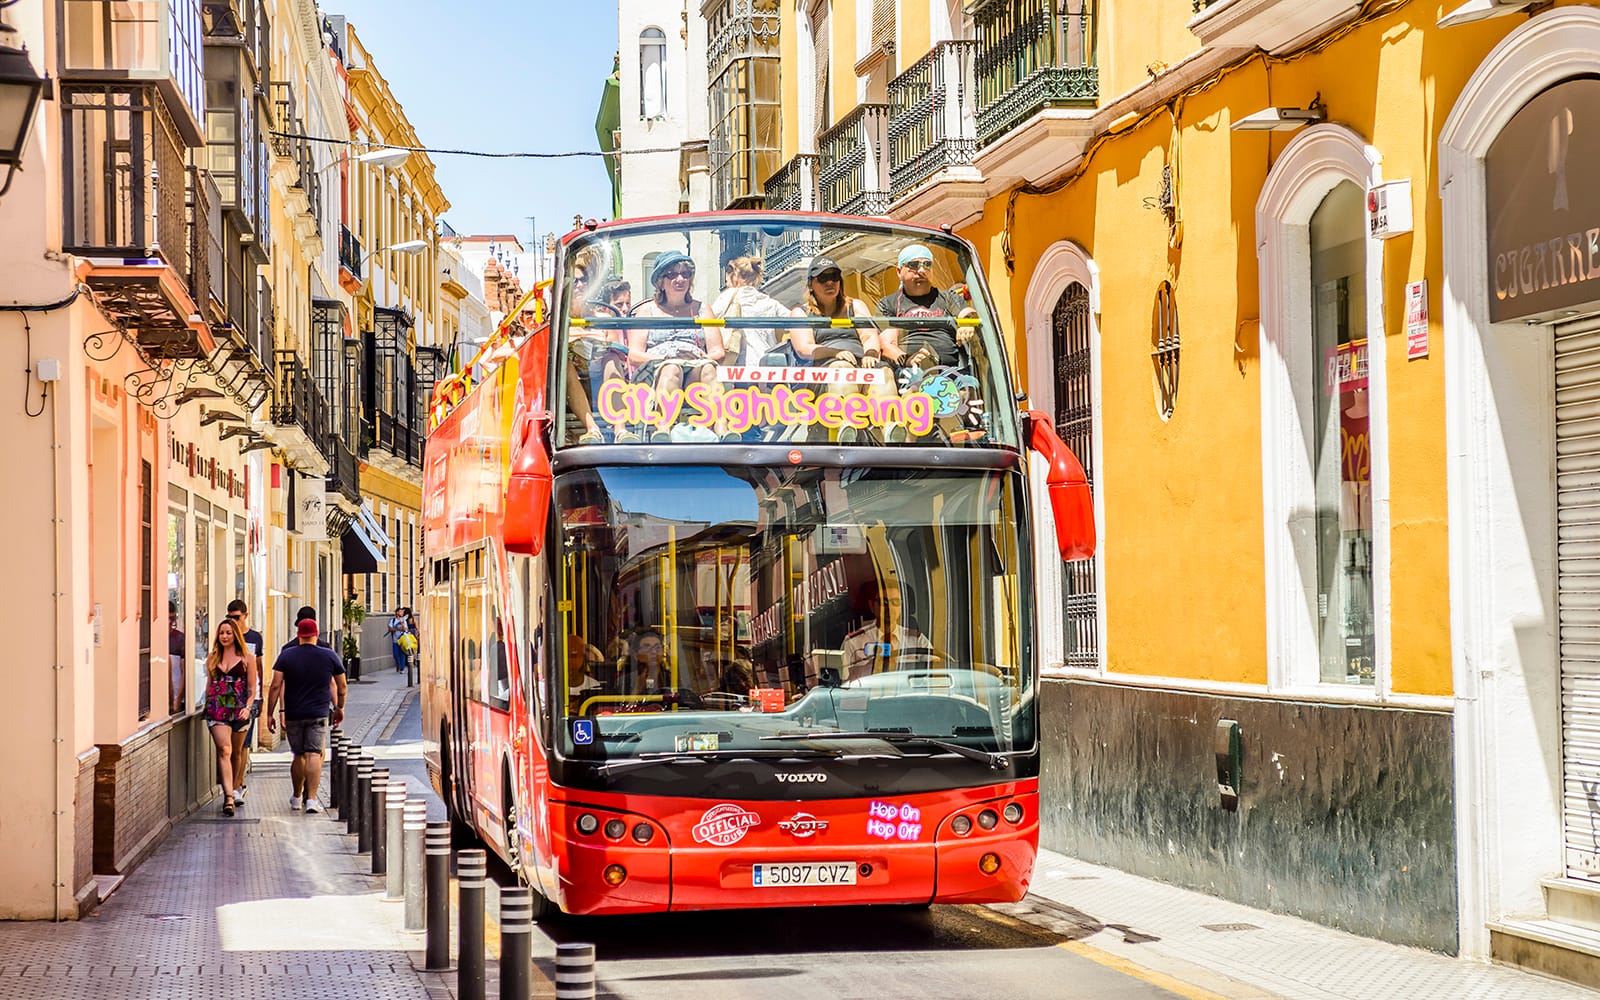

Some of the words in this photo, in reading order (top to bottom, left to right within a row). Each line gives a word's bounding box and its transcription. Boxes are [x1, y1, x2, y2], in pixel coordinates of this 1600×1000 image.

[727, 367, 876, 383] Worldwide
[598, 378, 682, 427] City
[685, 381, 934, 437] Sightseeing
[774, 773, 827, 783] VOLVO
[870, 801, 897, 819] Hop
[901, 803, 920, 820] On
[699, 813, 757, 838] OFFICIAL
[867, 820, 896, 839] Hop
[898, 822, 921, 840] Off
[718, 829, 744, 843] TOUR
[770, 866, 812, 883] 5097
[818, 865, 850, 883] CVZ
